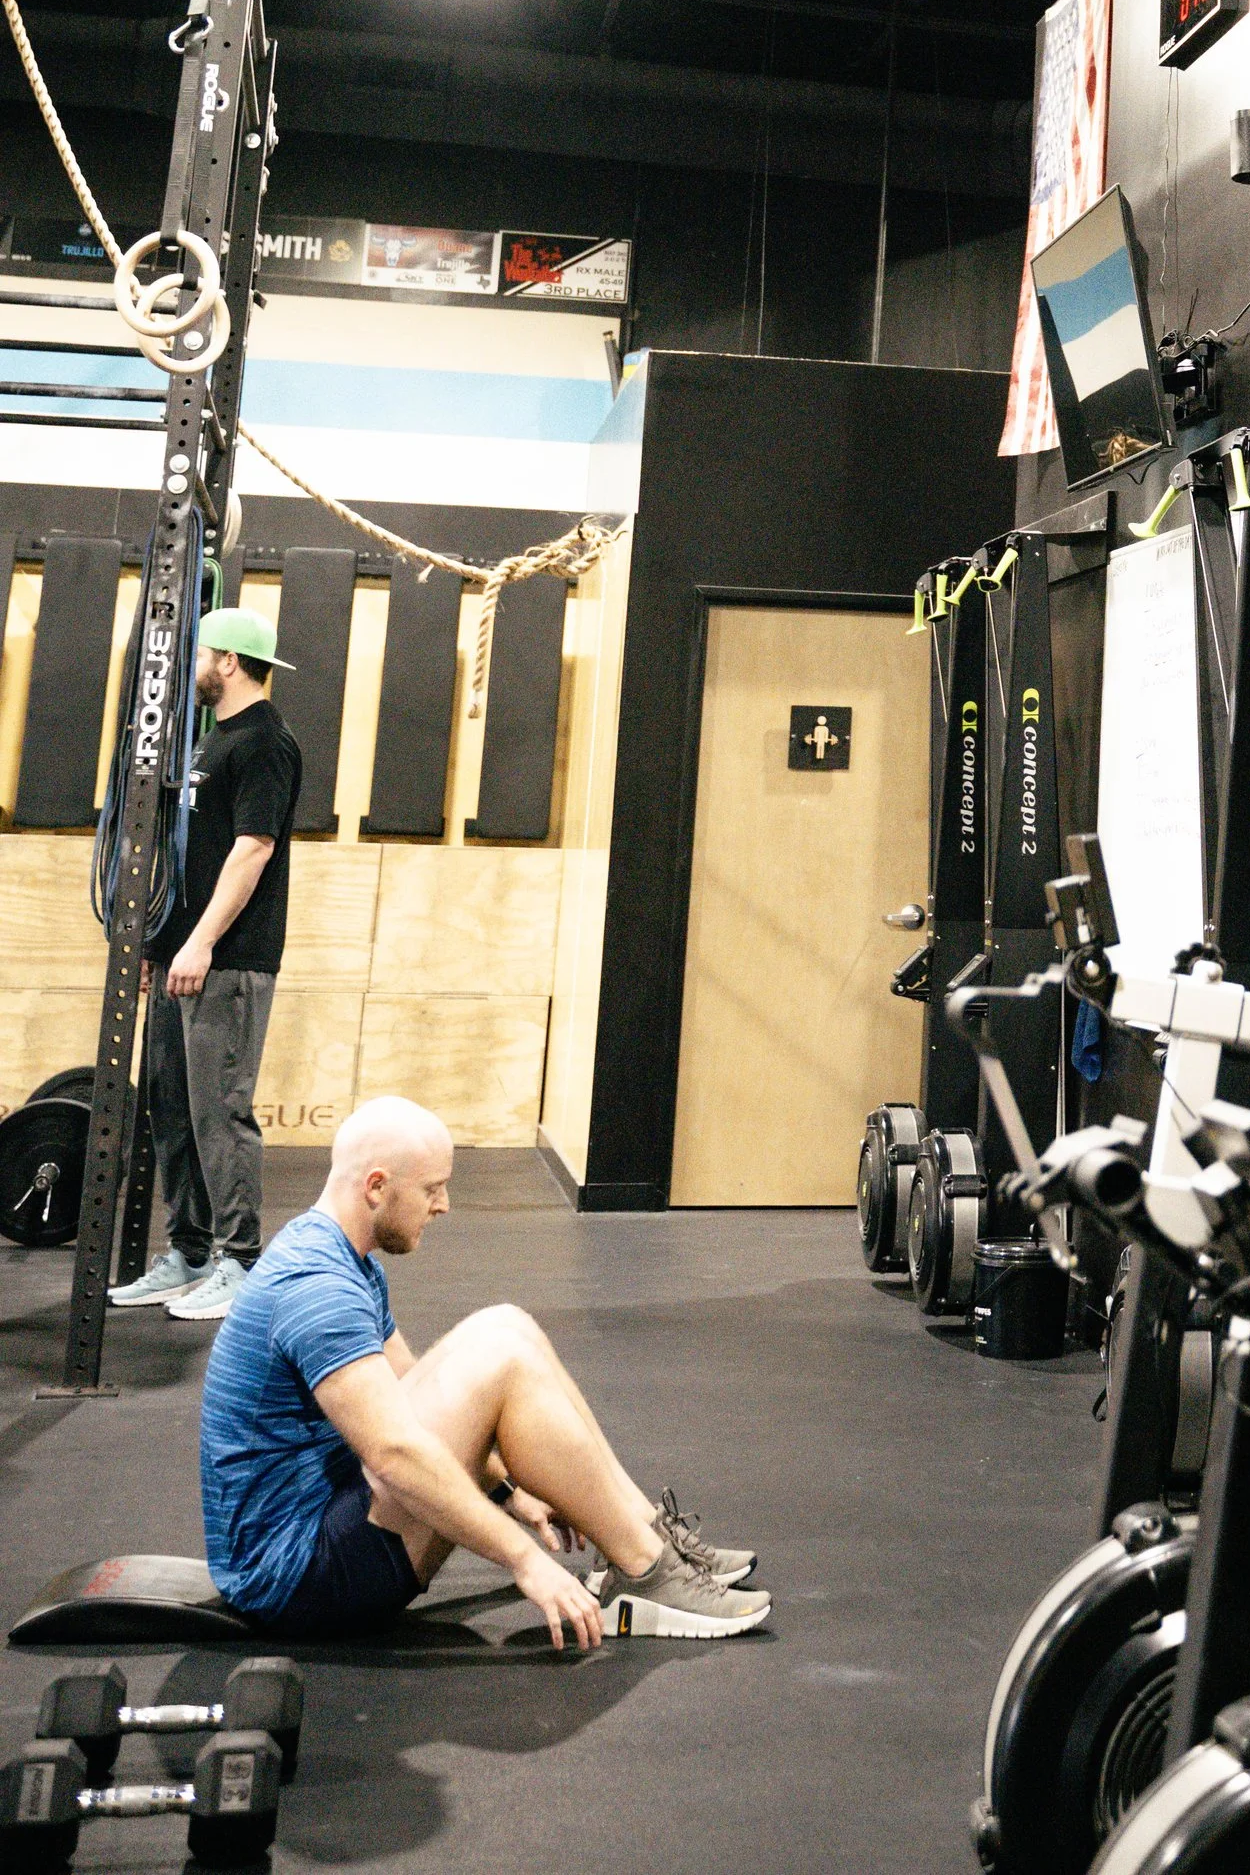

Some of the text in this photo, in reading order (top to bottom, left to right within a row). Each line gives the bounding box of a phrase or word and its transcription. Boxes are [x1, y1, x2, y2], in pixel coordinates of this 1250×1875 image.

[200, 63, 219, 133] ROGUE
[543, 283, 621, 299] 3RD PLACE
[576, 266, 625, 277] RX MALE
[136, 629, 172, 765] ROGUE
[960, 735, 976, 853] concept 2
[1020, 726, 1037, 854] concept 2
